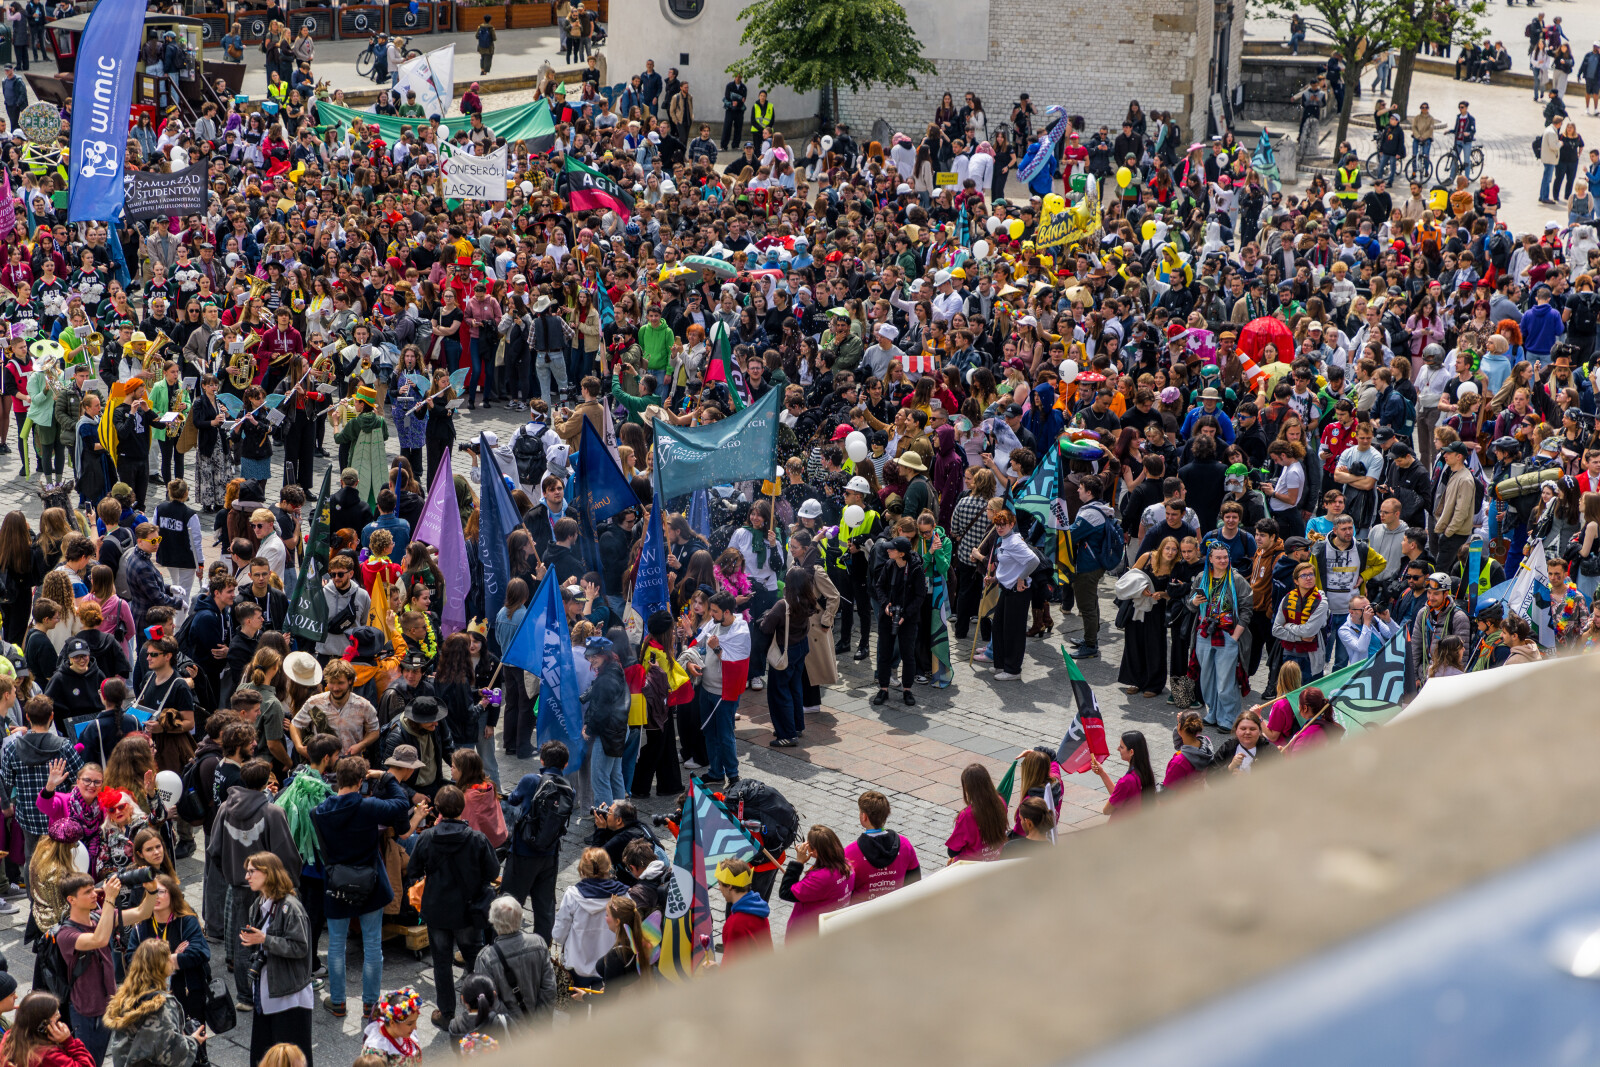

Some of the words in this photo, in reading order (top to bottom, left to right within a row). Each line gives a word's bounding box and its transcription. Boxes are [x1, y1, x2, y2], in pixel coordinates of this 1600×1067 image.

[91, 55, 116, 133] wimic
[136, 174, 200, 189] SAMORZĄD
[443, 179, 486, 197] LASZKI
[582, 172, 619, 197] AGH
[137, 185, 201, 200] STUDENTÓW
[16, 310, 34, 318] AGH
[159, 516, 183, 531] WMS
[869, 880, 896, 888] realme
